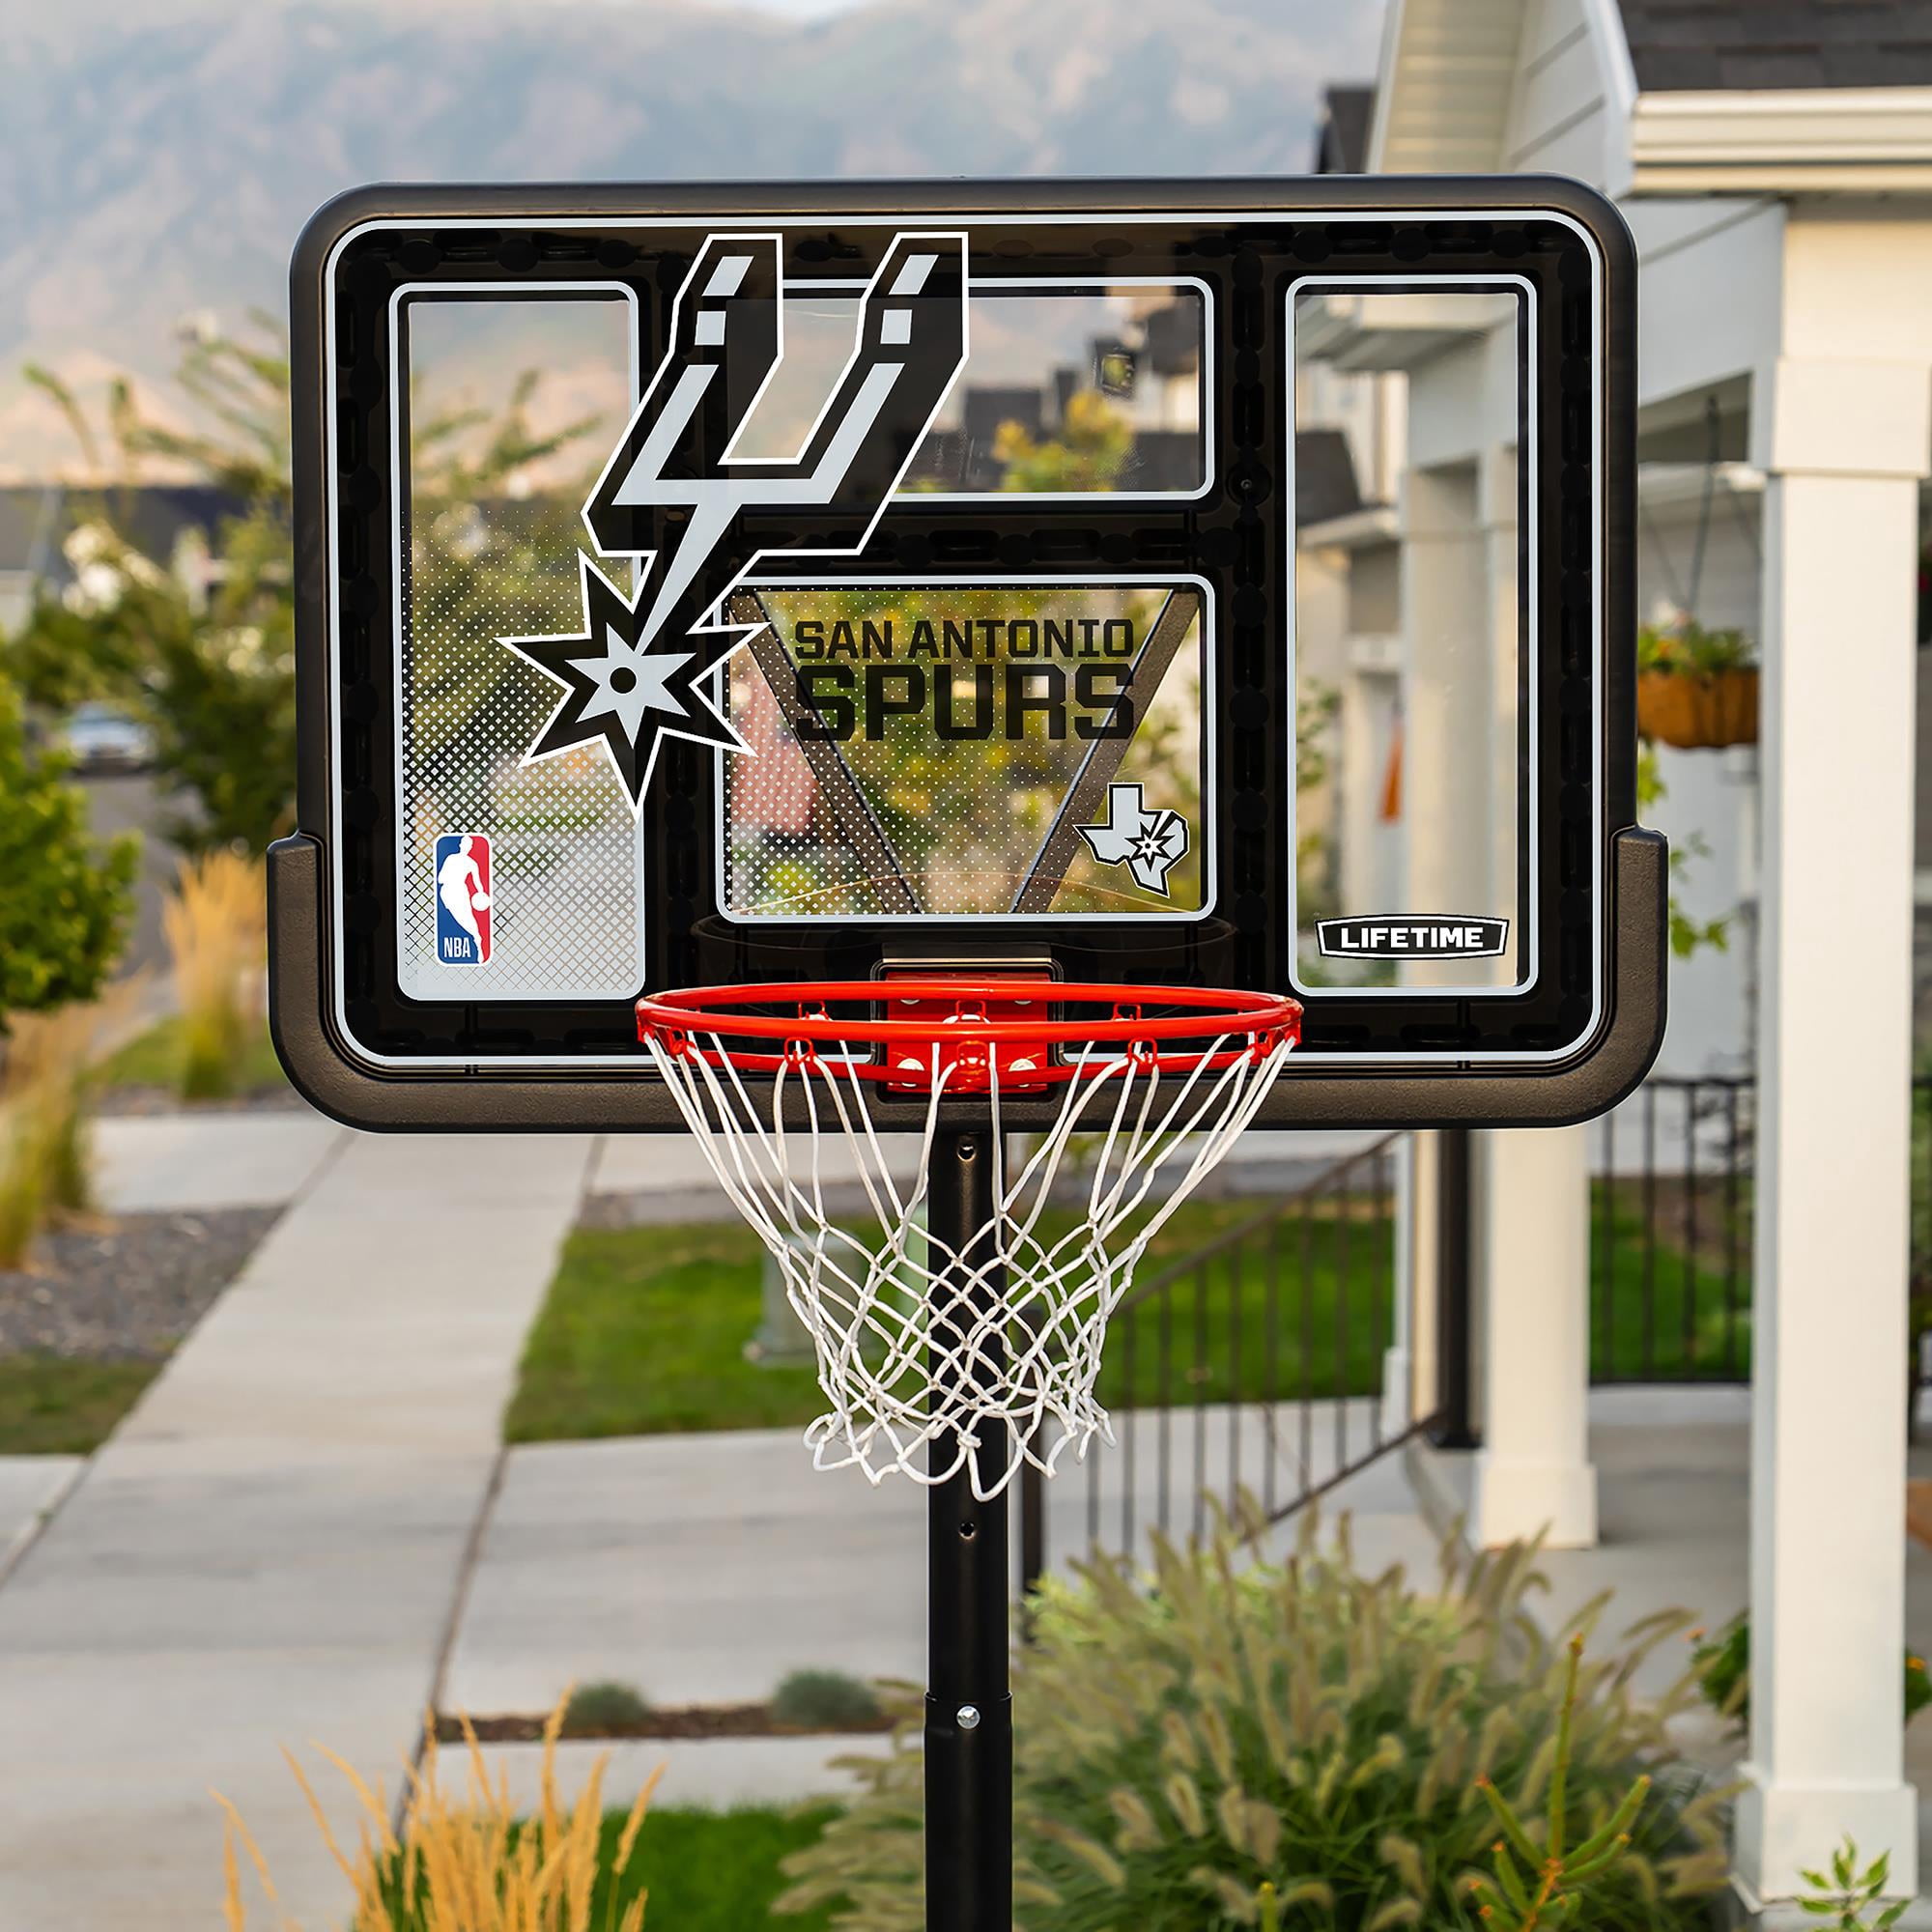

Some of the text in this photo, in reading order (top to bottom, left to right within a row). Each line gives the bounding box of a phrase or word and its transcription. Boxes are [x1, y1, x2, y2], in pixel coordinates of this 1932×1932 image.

[795, 619, 1133, 659] SAN ANTONIO
[796, 664, 1134, 741] SPURS
[443, 937, 470, 958] NBA
[1341, 926, 1484, 949] LIFETIME
